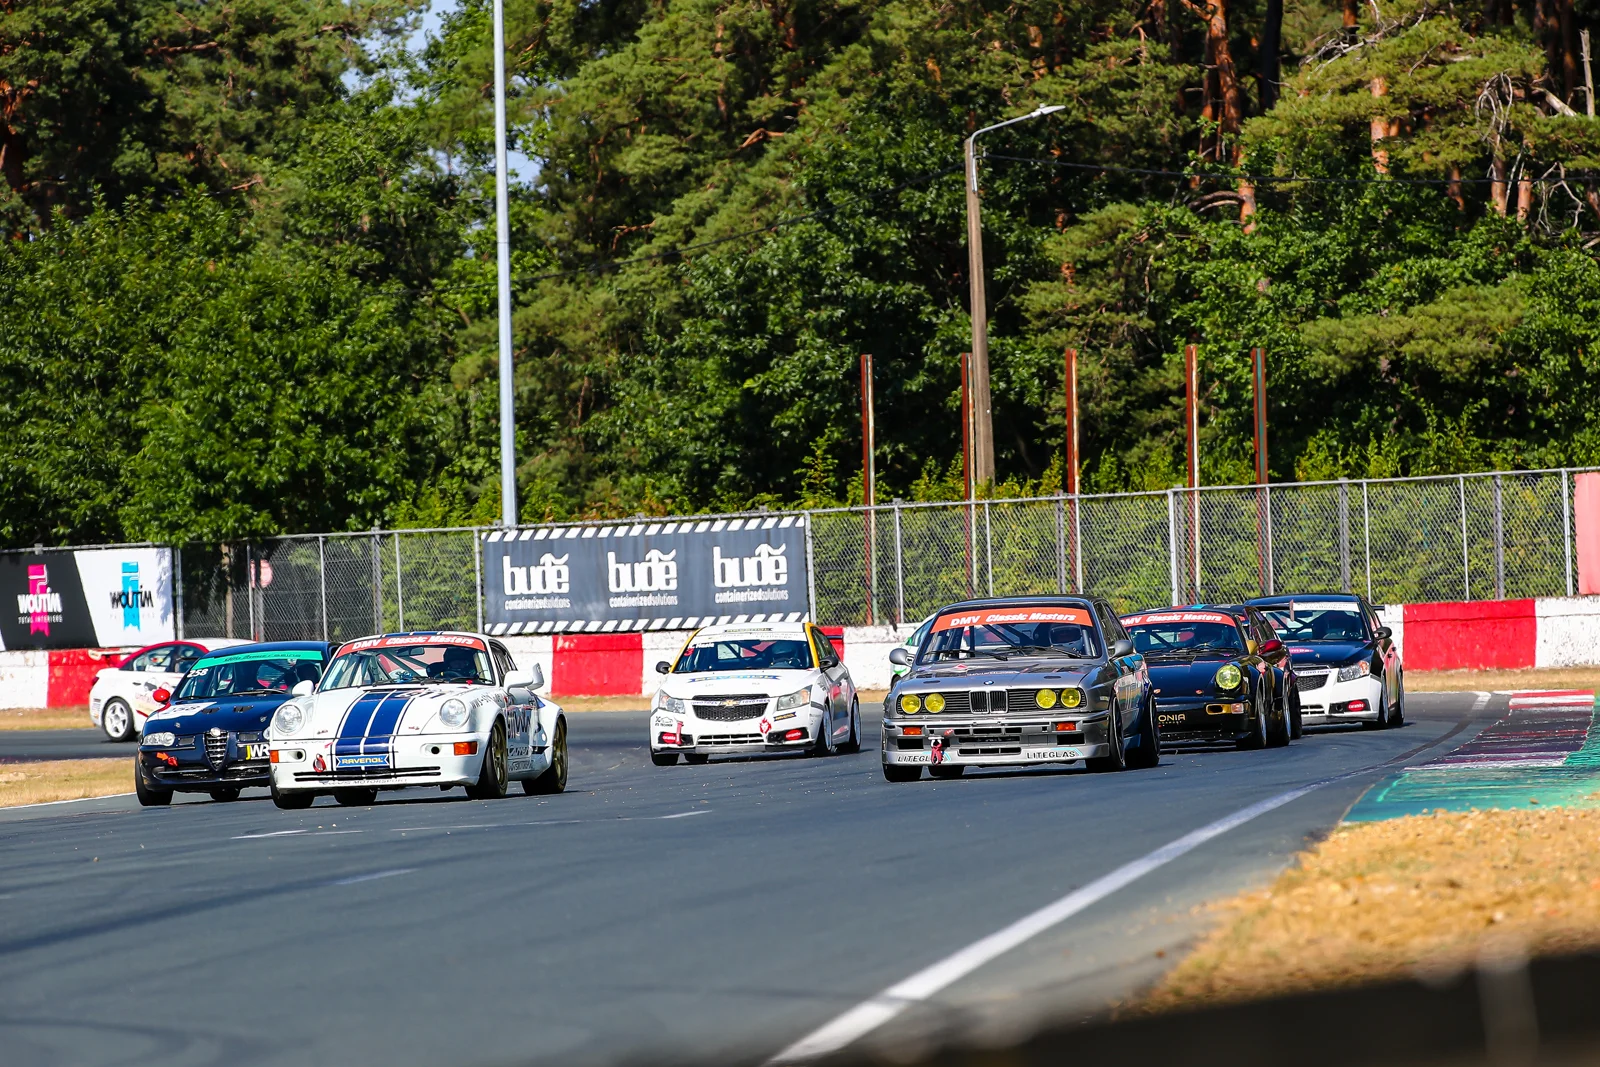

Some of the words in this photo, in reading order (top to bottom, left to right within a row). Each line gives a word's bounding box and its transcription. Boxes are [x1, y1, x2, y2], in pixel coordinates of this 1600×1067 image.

[950, 615, 981, 627] DMV
[986, 613, 1028, 623] Classic
[1028, 612, 1077, 622] Masters
[1146, 612, 1181, 623] Classic
[1182, 613, 1222, 622] Masters
[352, 639, 380, 650] DMV
[386, 636, 428, 646] Classic
[429, 635, 474, 645] Masters
[186, 668, 208, 678] 258
[1026, 751, 1076, 759] LITEGLAS
[341, 757, 383, 765] RAVENOL
